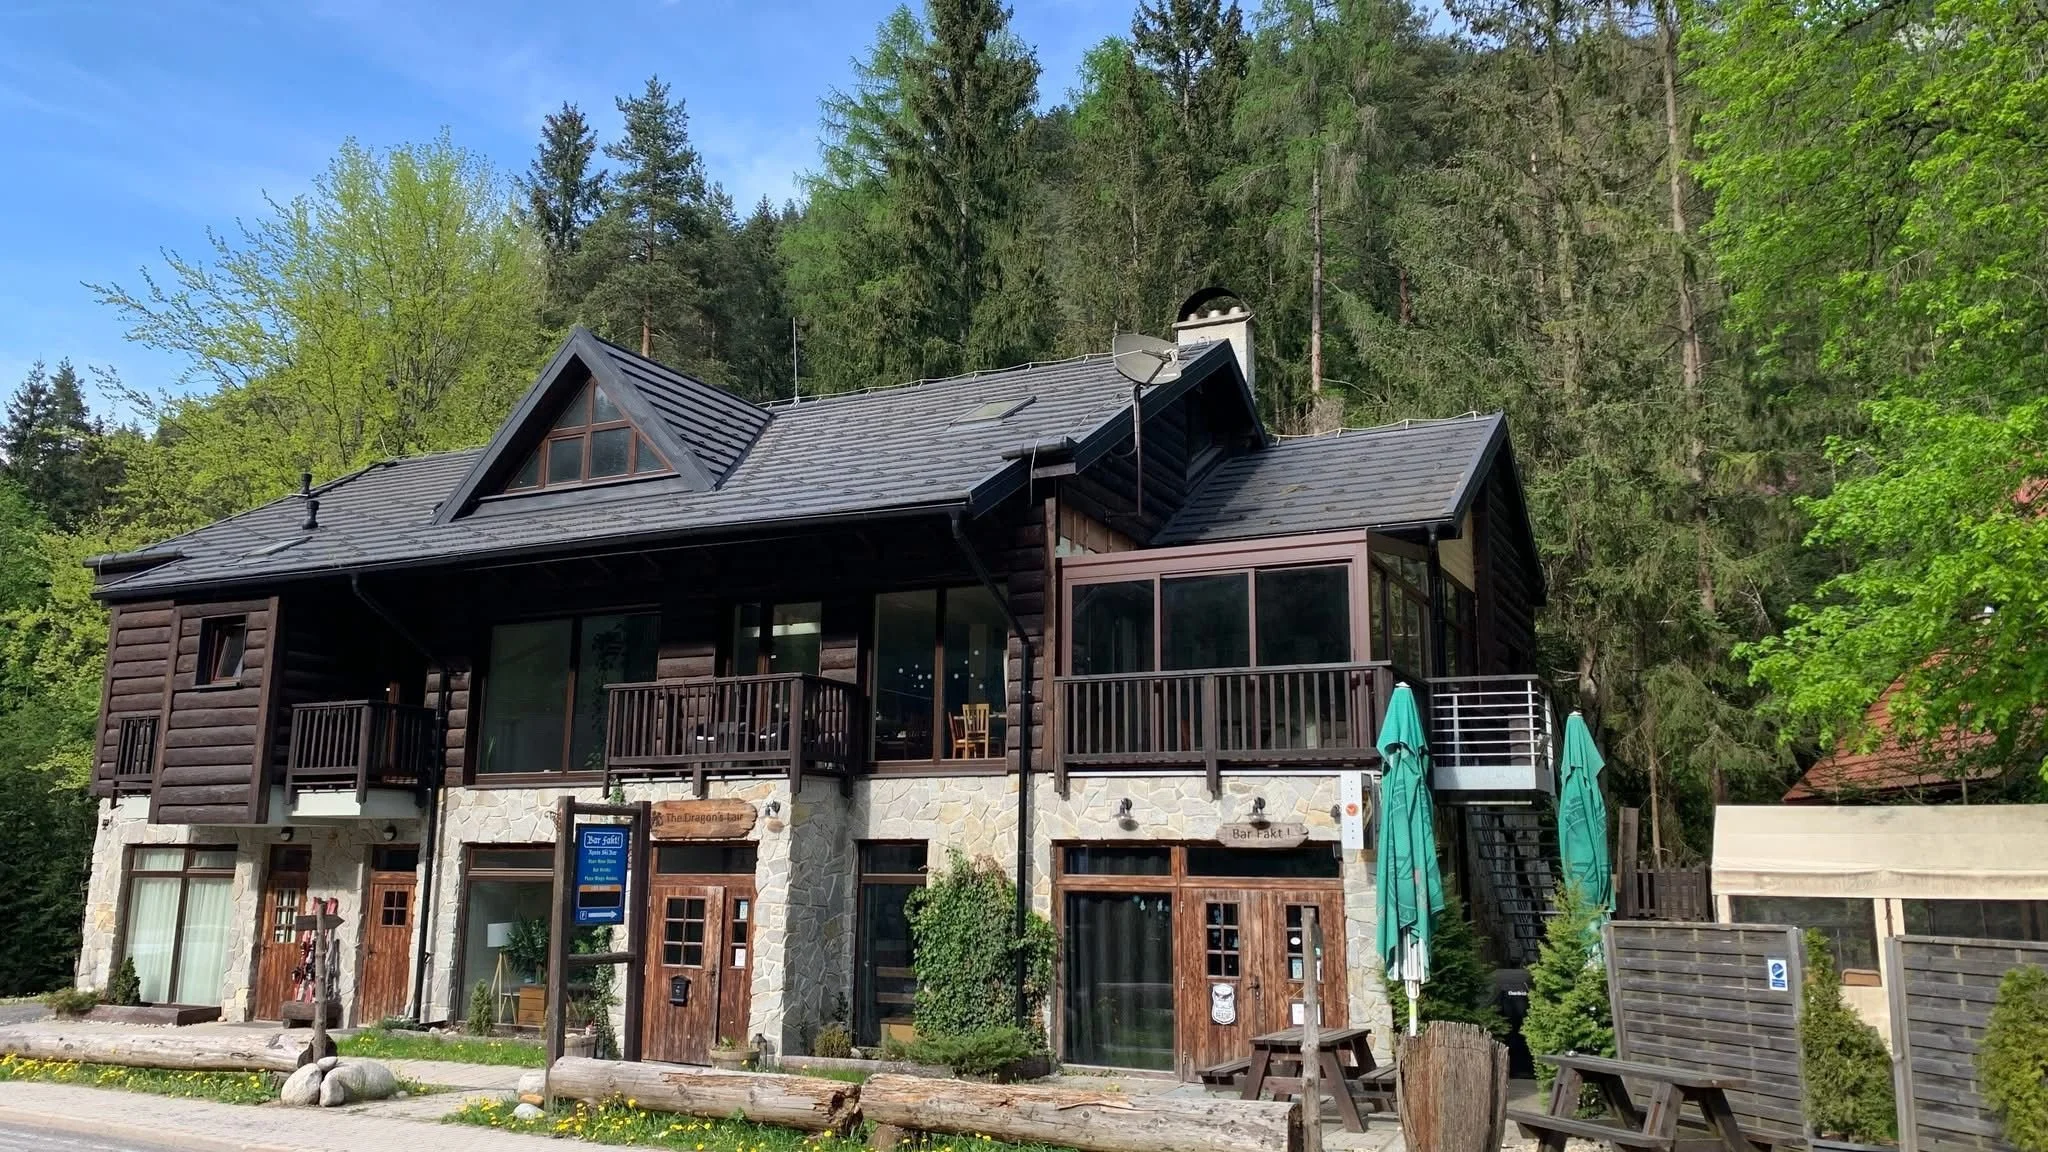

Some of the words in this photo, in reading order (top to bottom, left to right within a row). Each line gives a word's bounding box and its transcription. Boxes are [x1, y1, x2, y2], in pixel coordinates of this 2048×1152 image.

[666, 813, 683, 823] The
[684, 811, 723, 824] Dragon's
[727, 812, 744, 822] Lair
[1232, 828, 1251, 839] Bar
[1256, 827, 1282, 839] Fakt
[587, 835, 601, 845] Bar
